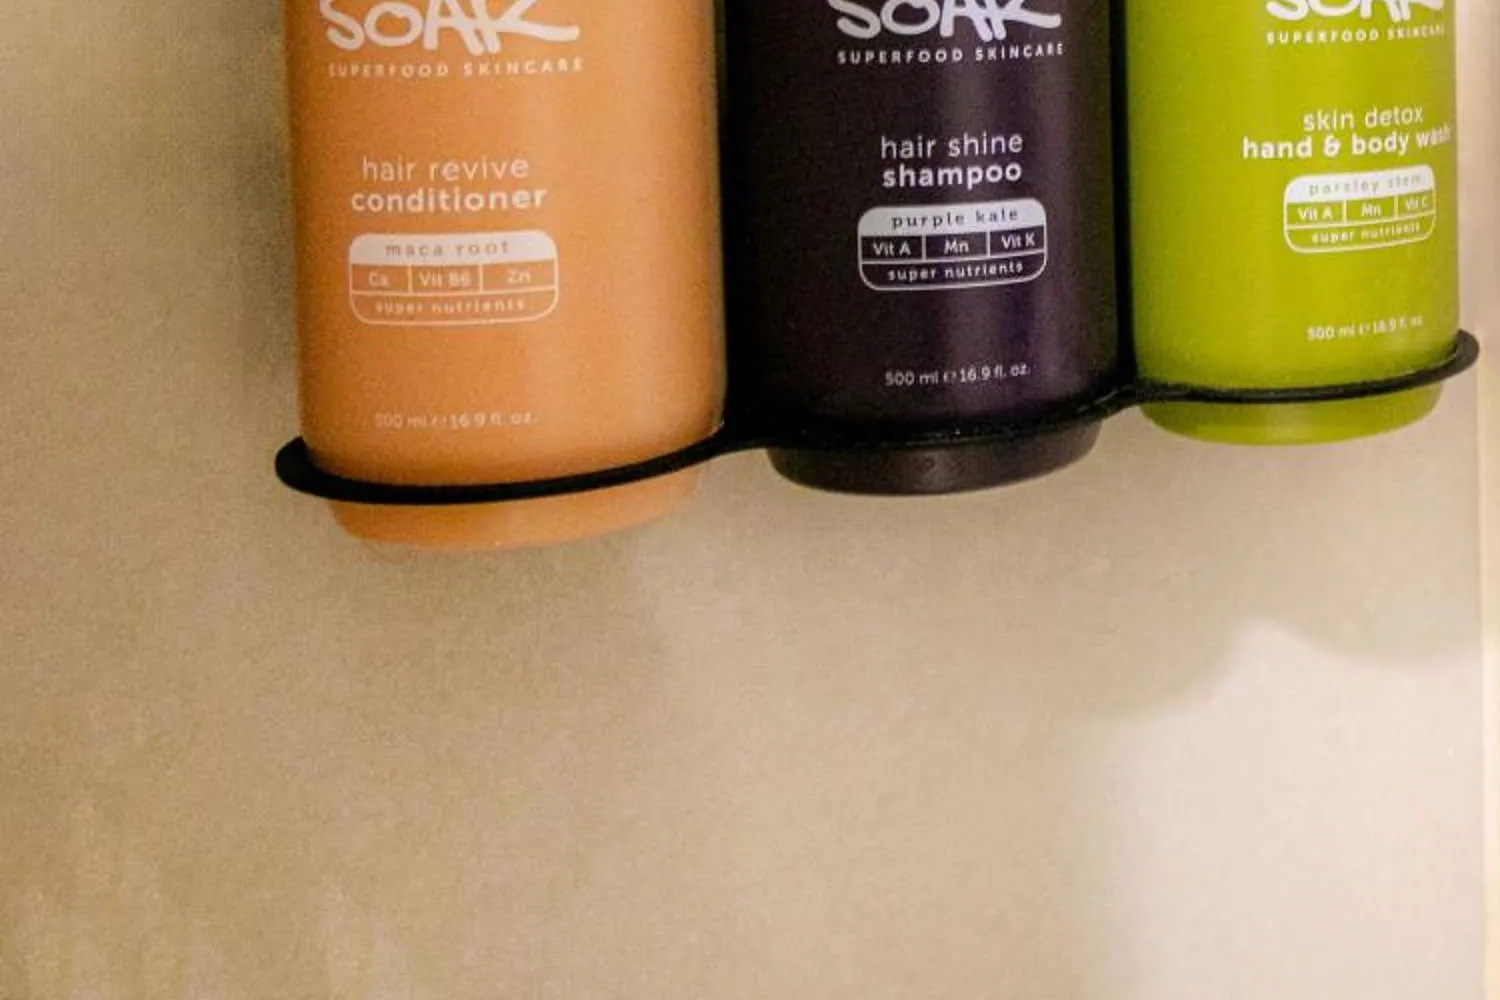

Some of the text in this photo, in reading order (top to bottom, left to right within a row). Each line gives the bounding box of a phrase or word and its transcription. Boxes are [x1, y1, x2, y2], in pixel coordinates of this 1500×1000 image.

[1266, 28, 1379, 45] SUPERFOOD
[837, 42, 1065, 65] SUPERFOOD SKINCARE
[328, 56, 584, 79] SUPERFOOD SKINCARE
[1303, 105, 1424, 132] skin detox
[880, 130, 1024, 160] hair shine
[1242, 135, 1313, 160] hand
[1324, 132, 1342, 158] &
[1351, 130, 1409, 156] body
[363, 156, 529, 182] hair revive
[883, 162, 1022, 190] shampoo
[351, 187, 548, 213] conditioner
[891, 207, 1019, 230] purple kale
[1297, 206, 1333, 221] Vit A
[1361, 203, 1382, 217] Mn
[943, 239, 970, 254] Mn
[1002, 231, 1036, 250] Vit K
[1312, 230, 1355, 246] super
[385, 240, 509, 258] maca root
[873, 241, 912, 257] Vit A
[507, 269, 532, 283] Zn
[888, 260, 1024, 281] super nutrients
[375, 299, 525, 316] super nutrients
[885, 370, 915, 386] 500
[919, 370, 939, 385] ml
